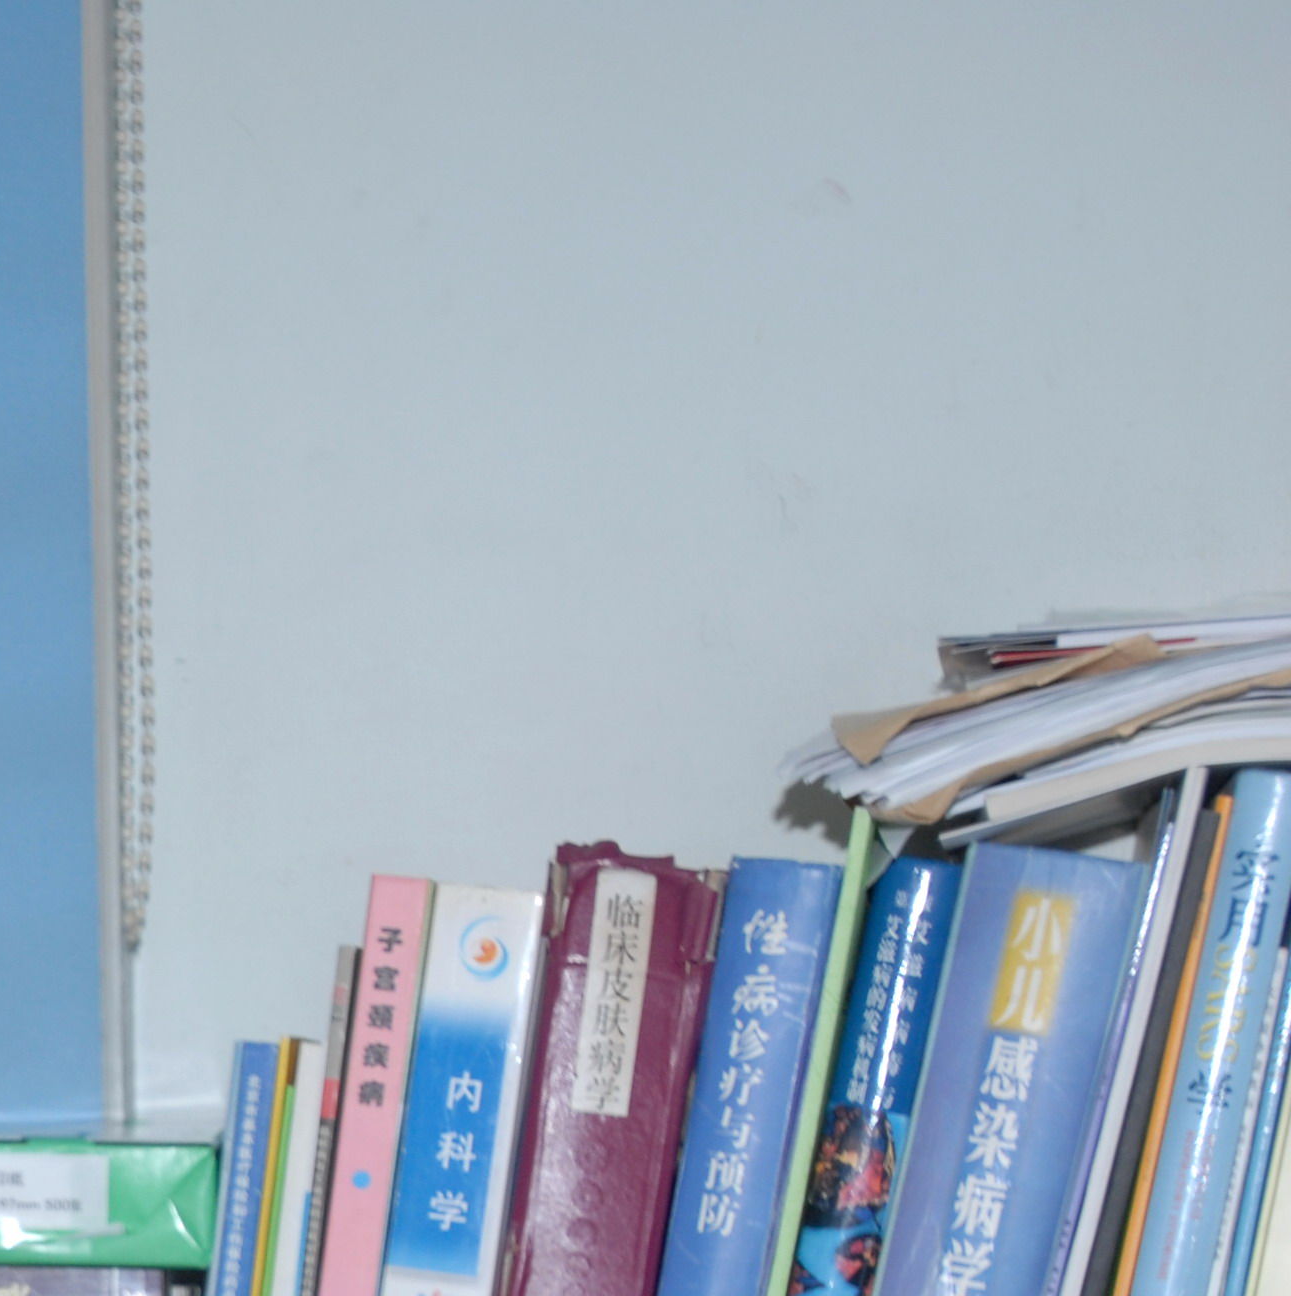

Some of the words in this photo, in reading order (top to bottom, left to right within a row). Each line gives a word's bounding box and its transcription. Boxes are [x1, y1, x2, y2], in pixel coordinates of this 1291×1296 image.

[357, 926, 403, 1107] 子宫颈疾病
[587, 893, 643, 1110] 临床皮肤病学
[696, 907, 789, 1237] 性病诊疗与预防
[427, 1070, 483, 1232] 内科学
